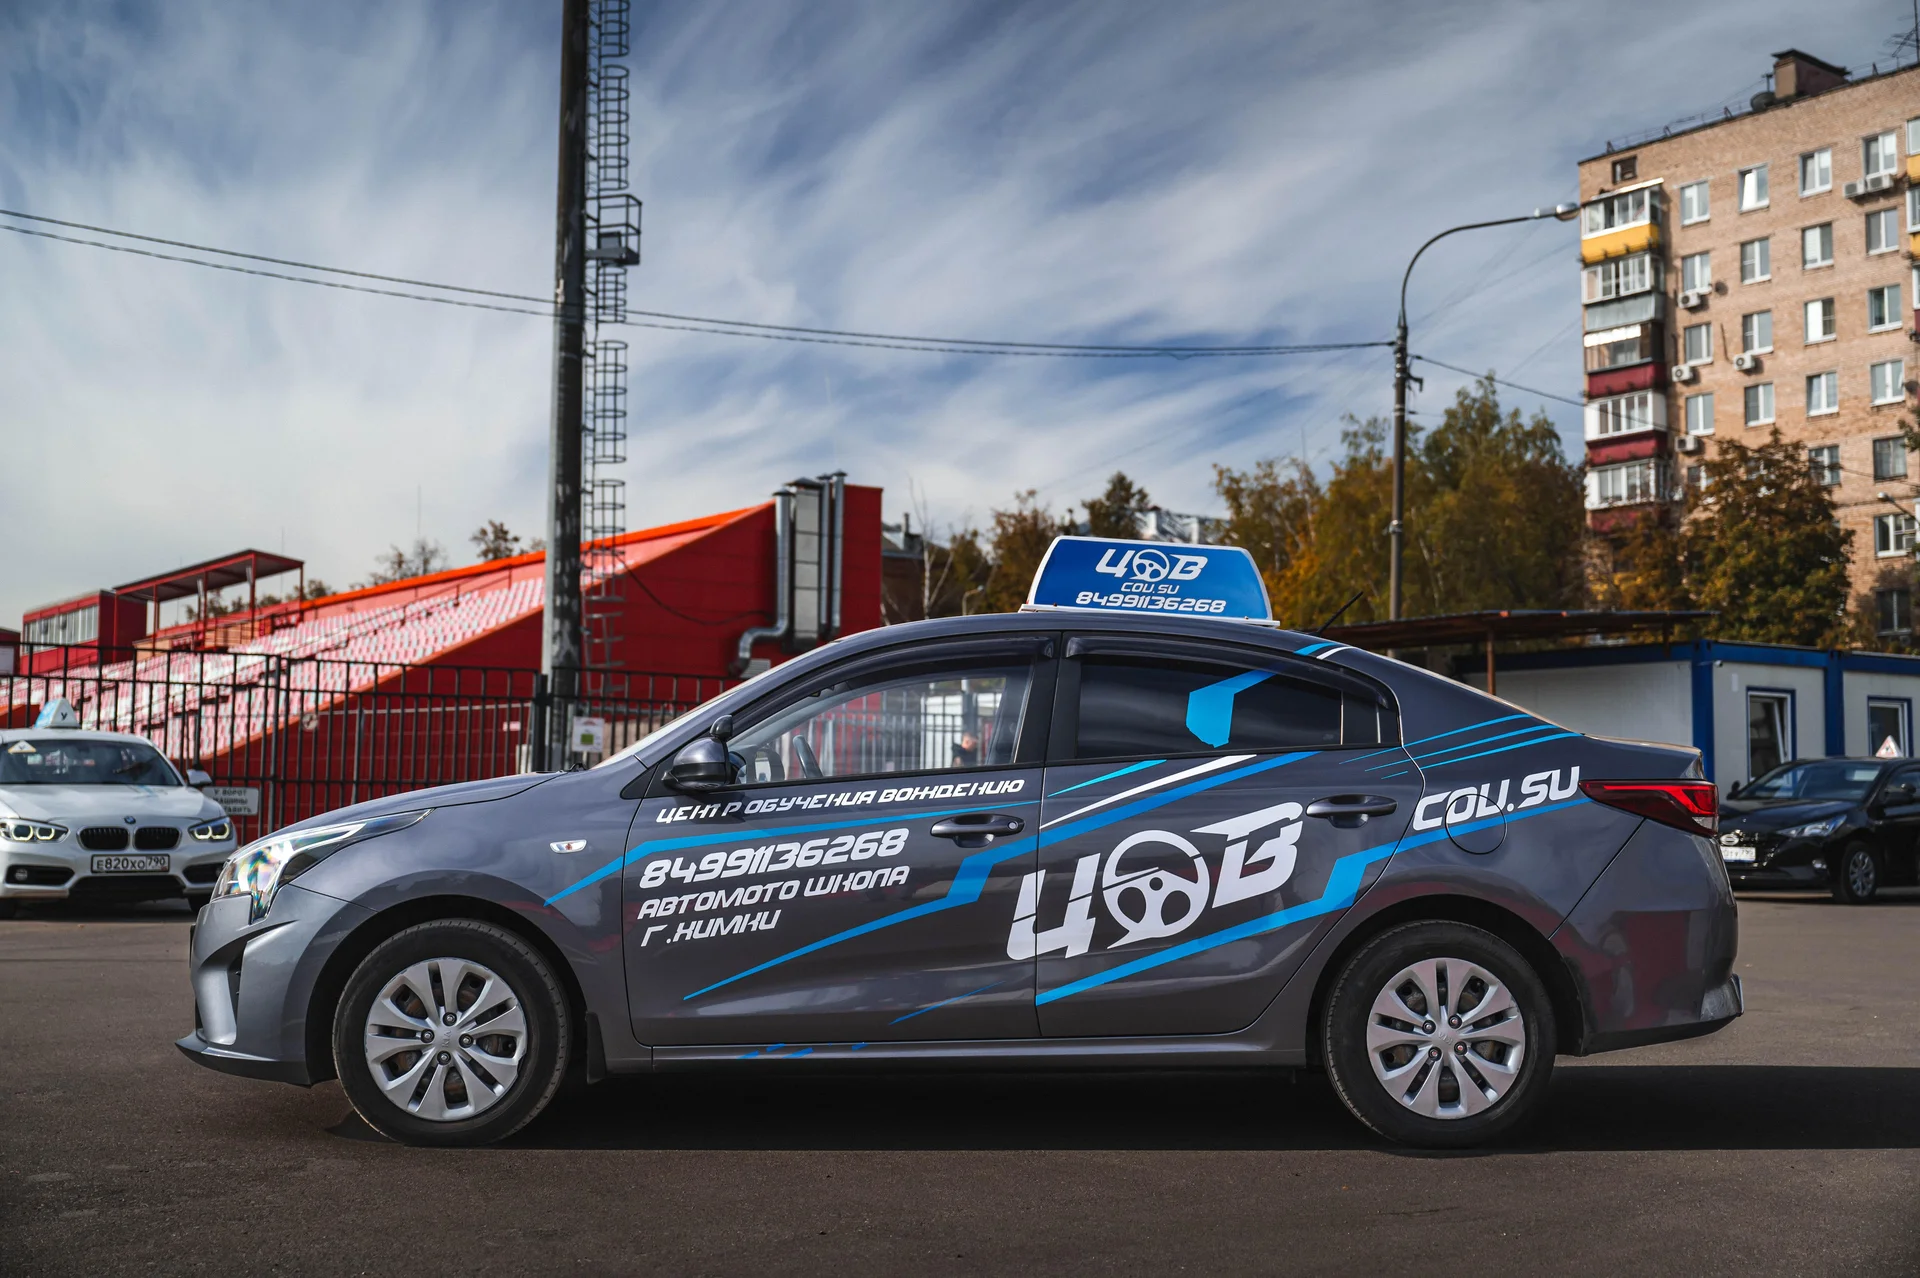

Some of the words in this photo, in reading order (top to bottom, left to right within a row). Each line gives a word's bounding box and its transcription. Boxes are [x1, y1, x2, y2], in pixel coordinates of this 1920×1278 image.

[1075, 591, 1227, 613] 84991136268
[744, 790, 878, 814] ОБУЧЕНИЯ
[877, 779, 1026, 804] ВОЖДЕНИЮ
[147, 856, 166, 867] 790
[639, 828, 909, 889] 84991136268
[637, 880, 801, 920] АВТОМОТО
[803, 865, 911, 897] ШКОЛА
